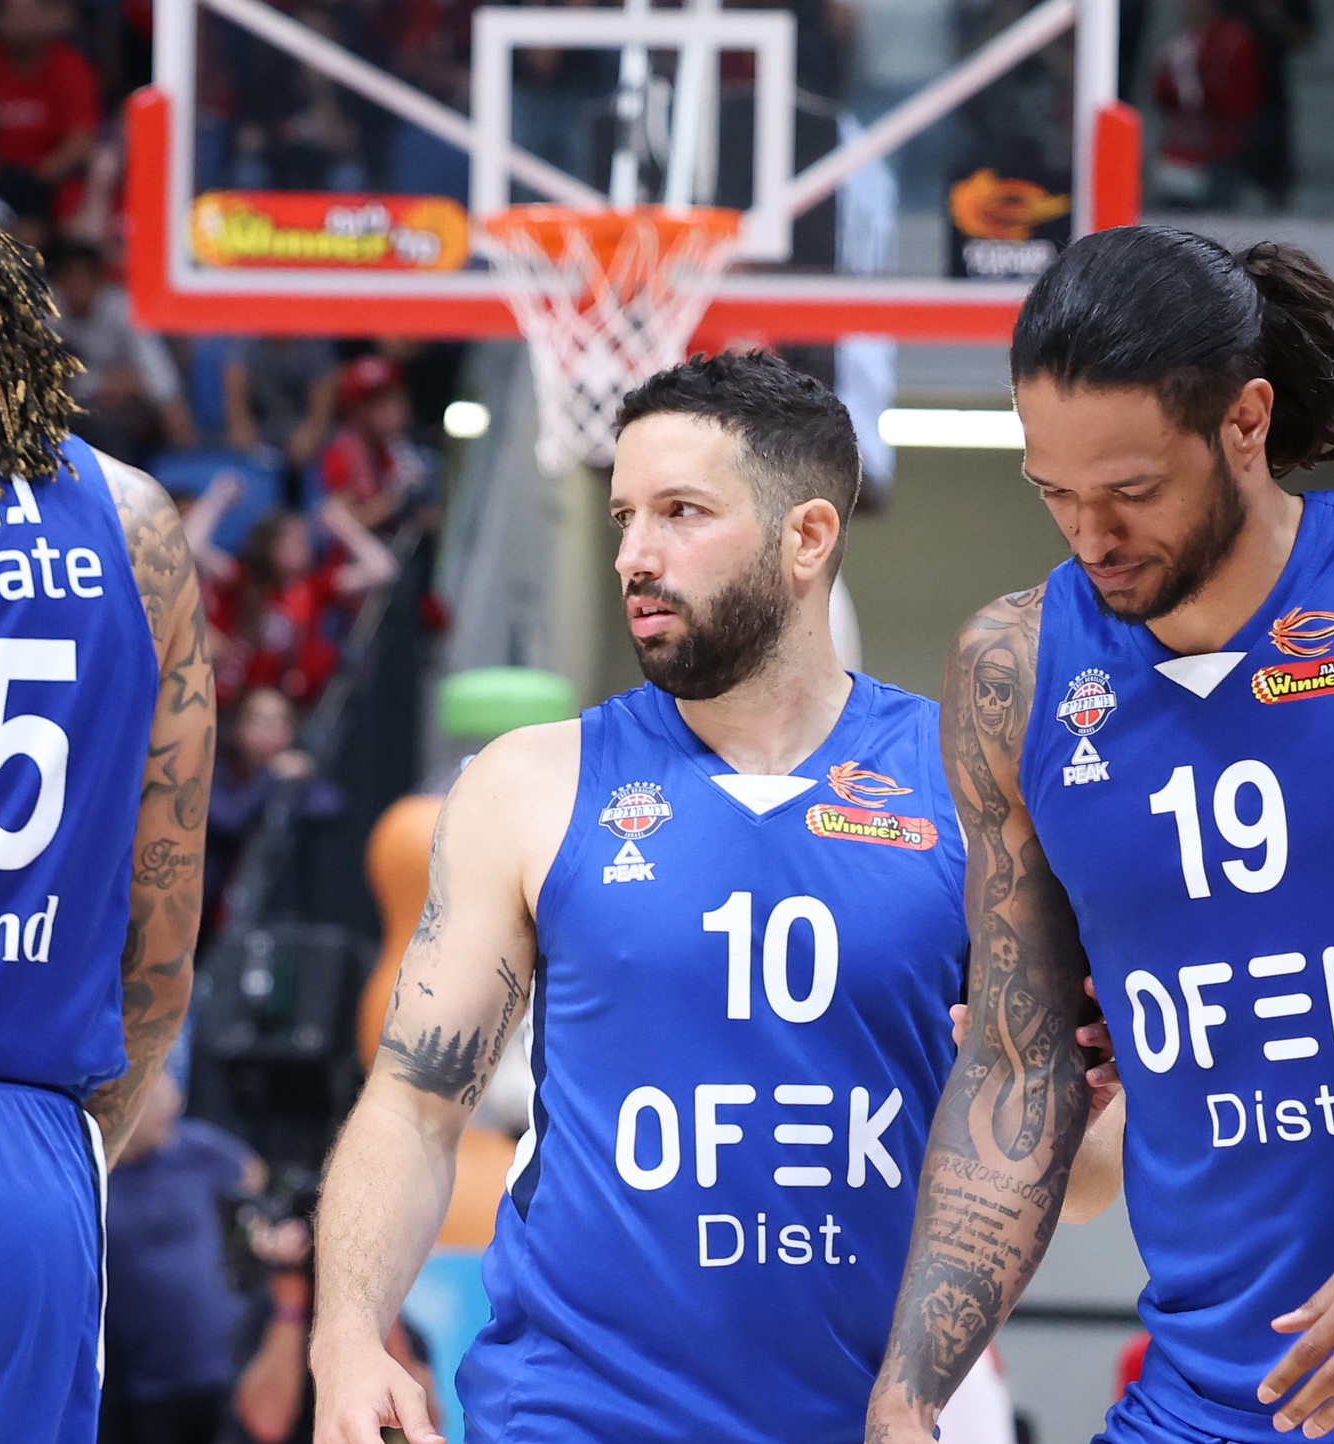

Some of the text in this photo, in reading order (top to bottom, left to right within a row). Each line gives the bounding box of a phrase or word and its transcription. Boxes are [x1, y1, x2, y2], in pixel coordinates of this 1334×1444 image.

[1063, 760, 1111, 786] PEAK
[820, 812, 922, 844] Winner סל
[1149, 759, 1289, 899] 19
[602, 862, 657, 885] PEAK
[702, 891, 839, 1023] 10
[614, 1083, 904, 1191] OFEK
[697, 1212, 857, 1268] Dist.
